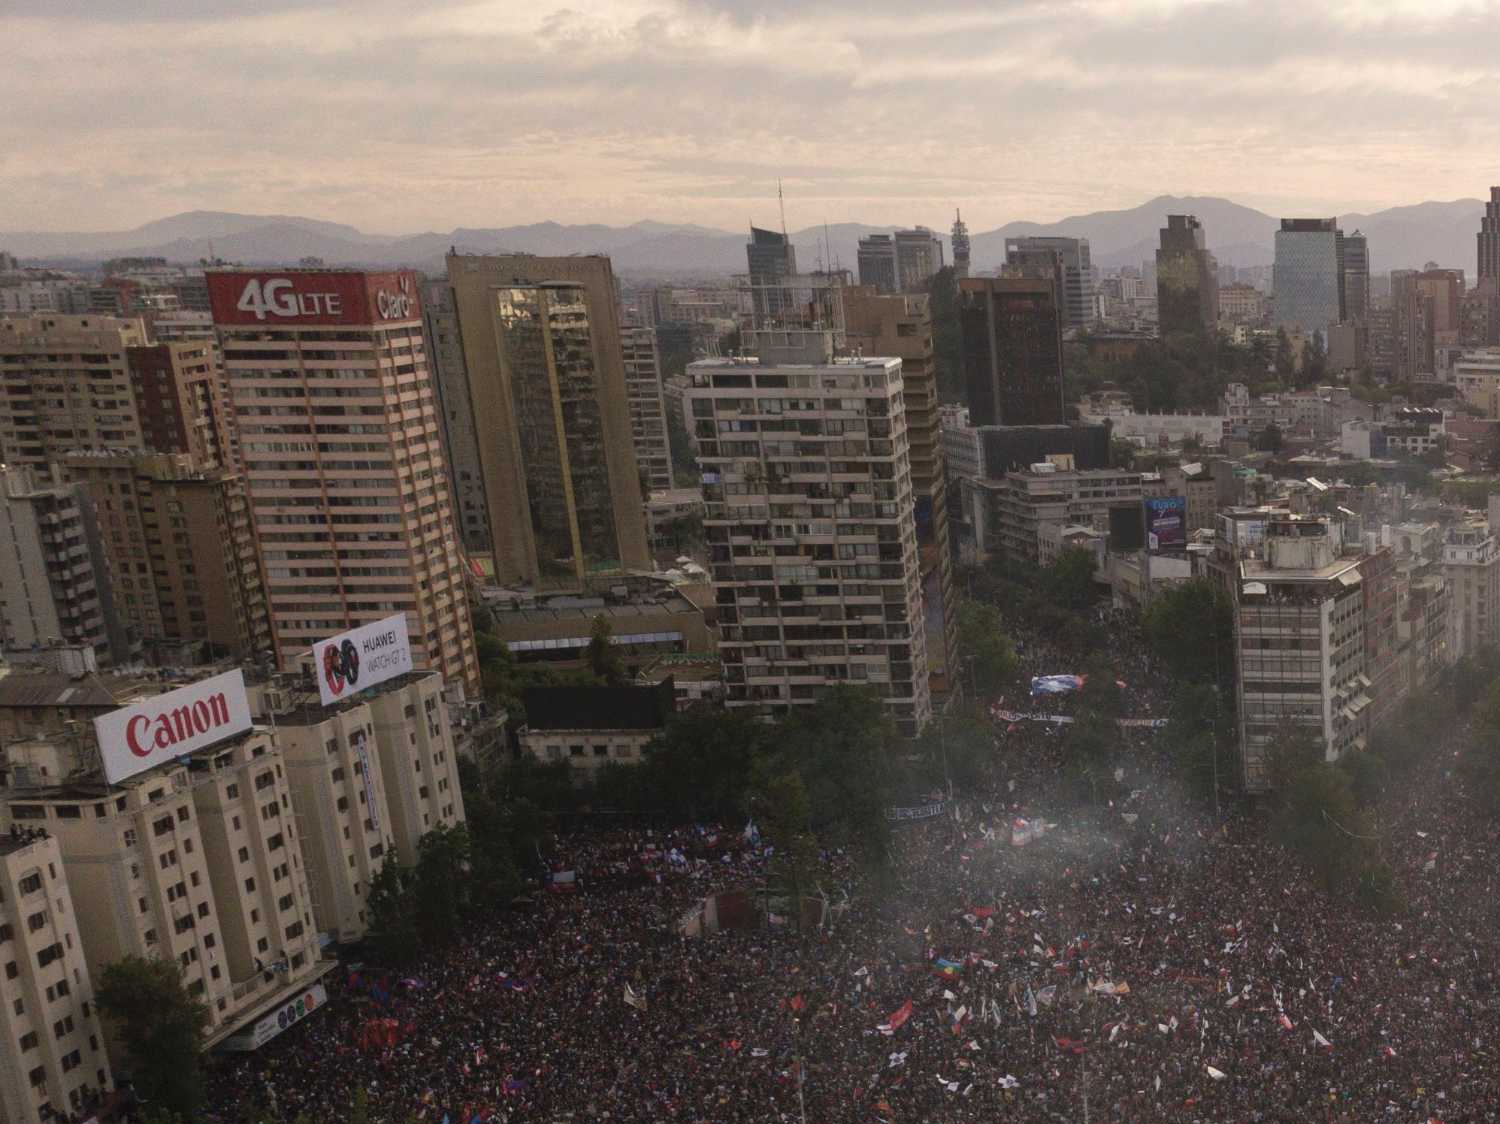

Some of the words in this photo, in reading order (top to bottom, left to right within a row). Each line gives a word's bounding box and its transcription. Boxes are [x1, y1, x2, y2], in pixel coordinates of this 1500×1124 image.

[377, 288, 409, 320] Claro
[362, 630, 397, 654] HUAWEI
[126, 692, 230, 758] Canon
